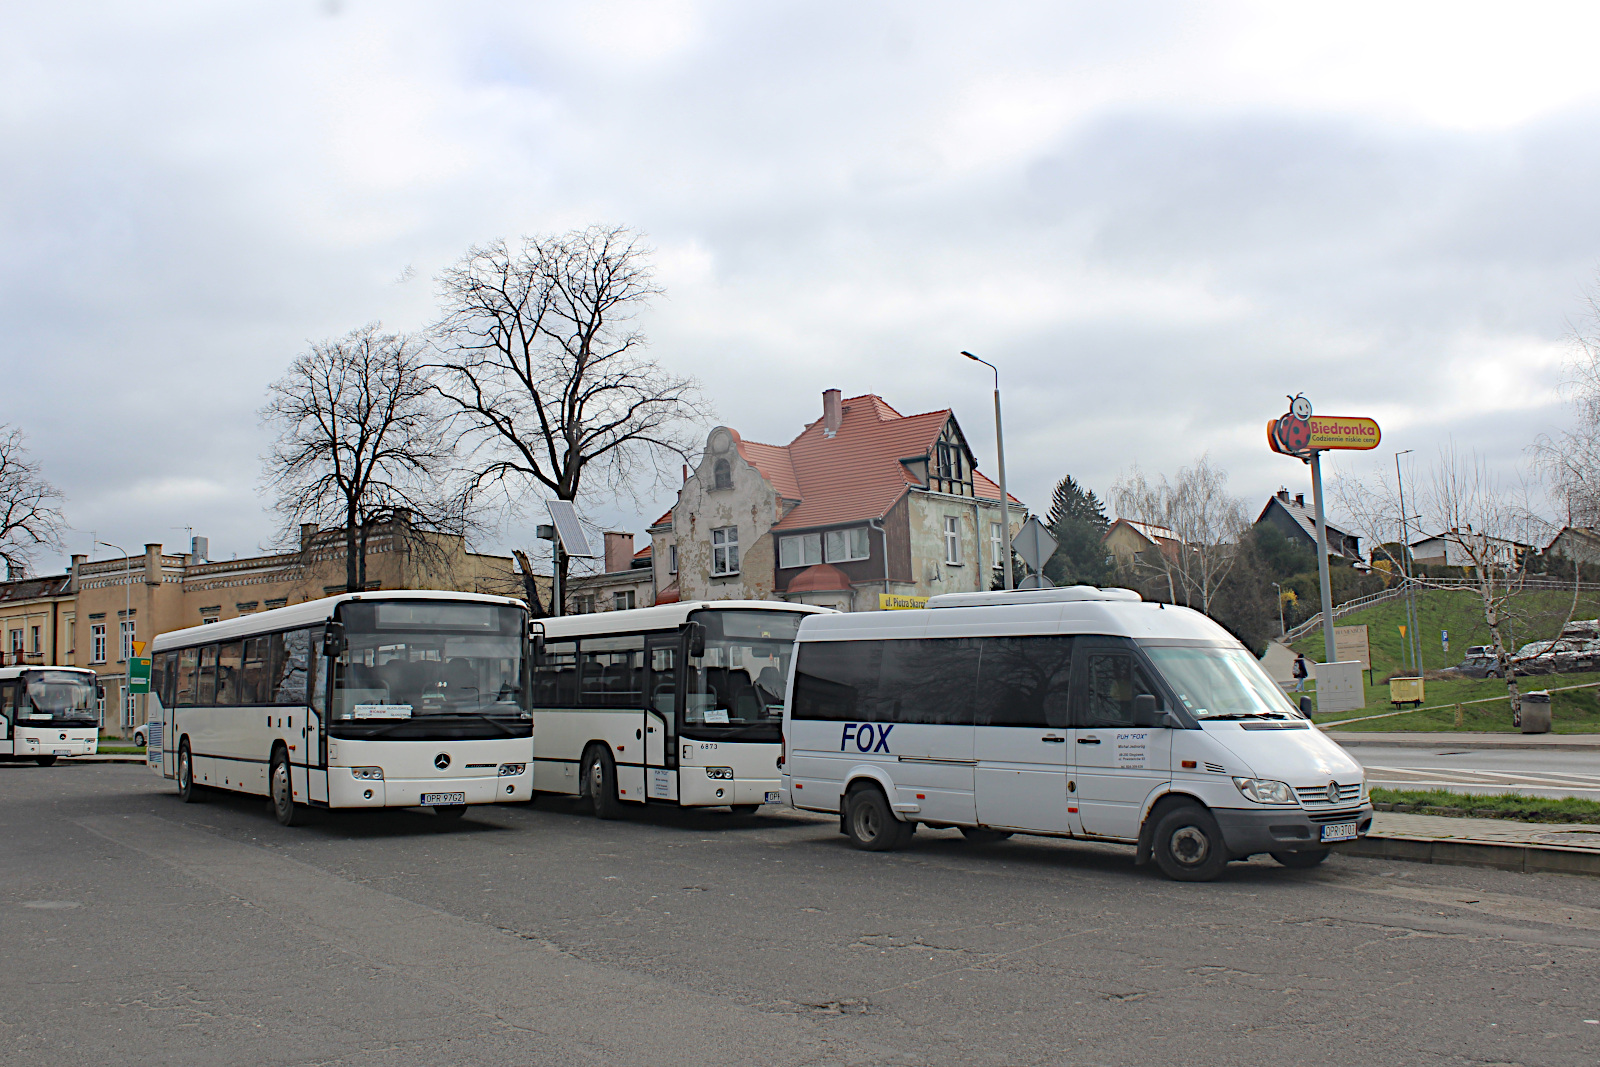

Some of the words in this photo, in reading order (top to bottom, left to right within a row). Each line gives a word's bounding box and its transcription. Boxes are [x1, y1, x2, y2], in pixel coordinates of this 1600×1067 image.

[1311, 422, 1375, 436] Biedronka
[841, 723, 894, 753] FOX
[1326, 825, 1339, 836] OPR
[1341, 825, 1354, 835] 3T03
